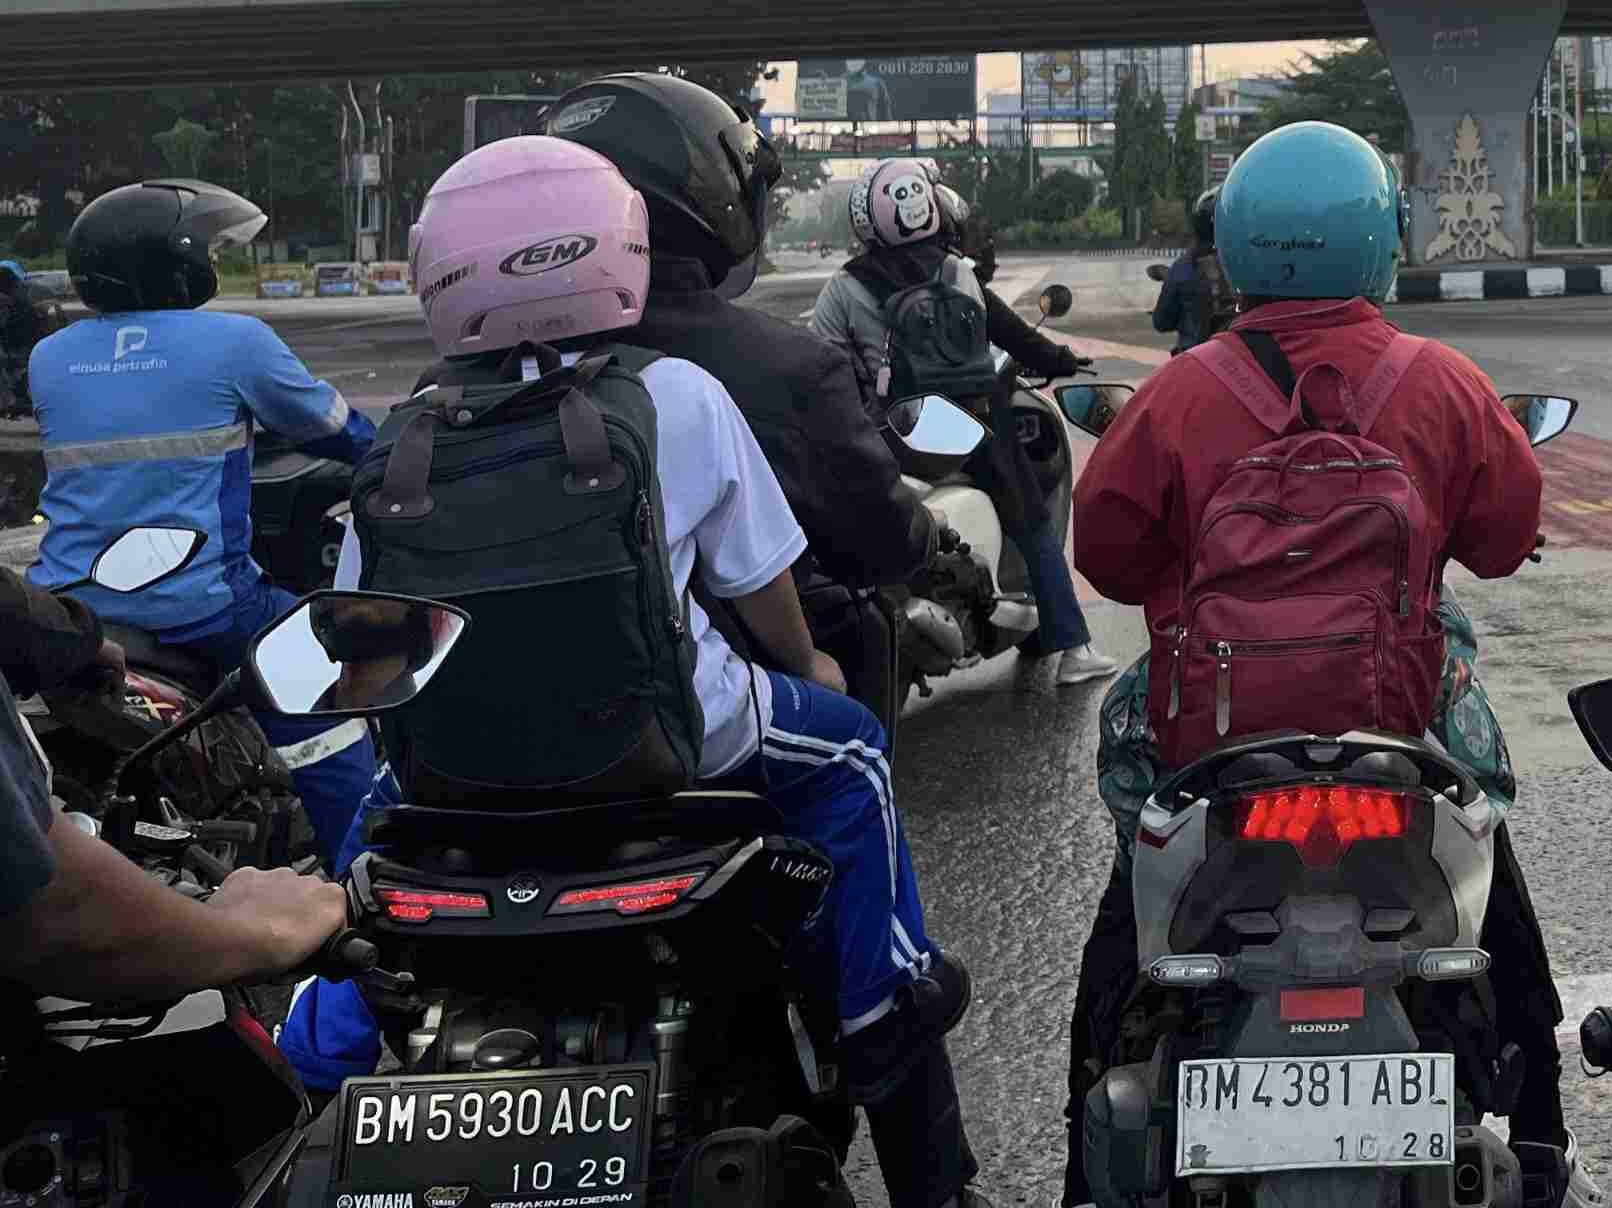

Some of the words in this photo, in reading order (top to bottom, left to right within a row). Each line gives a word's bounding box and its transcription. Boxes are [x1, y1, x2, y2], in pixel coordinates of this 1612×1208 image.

[521, 240, 581, 266] GM
[1289, 1023, 1352, 1034] HONDA
[1251, 1061, 1351, 1108] 4381
[1371, 1058, 1448, 1106] ABL
[354, 1094, 417, 1145] BM
[426, 1087, 543, 1142] 5930
[550, 1083, 634, 1136] ACC
[1403, 1132, 1445, 1158] 28
[511, 1160, 553, 1193] 10
[577, 1156, 626, 1189] 29
[353, 1192, 414, 1208] YAMAHA
